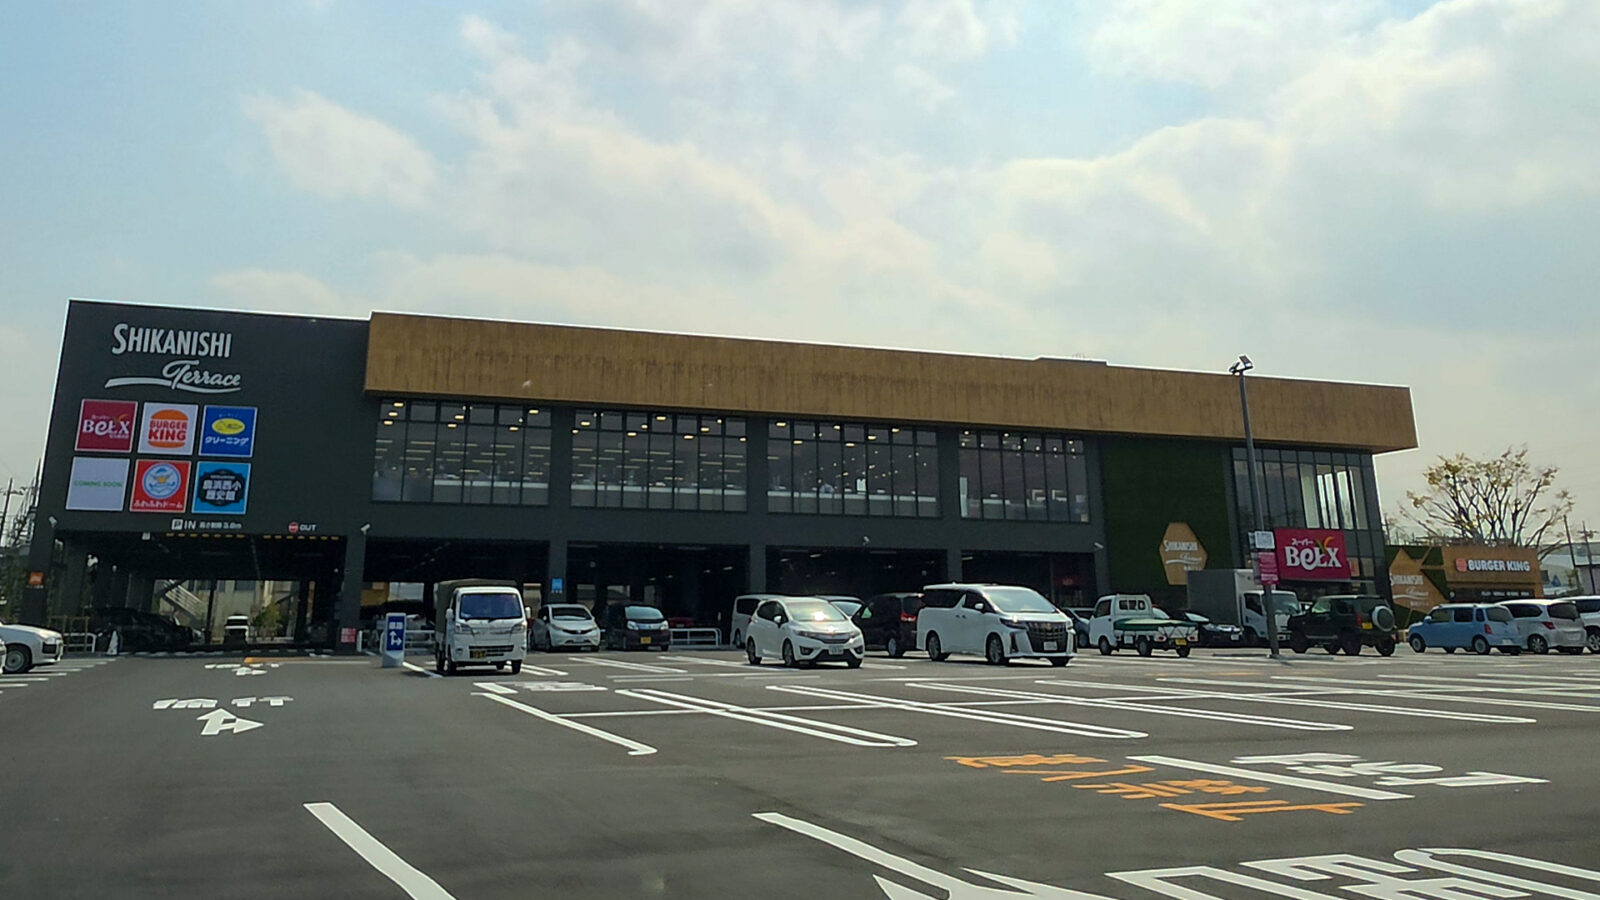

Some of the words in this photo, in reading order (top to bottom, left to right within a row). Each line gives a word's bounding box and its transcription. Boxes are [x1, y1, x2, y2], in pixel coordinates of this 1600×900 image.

[162, 359, 241, 390] Terrace
[149, 420, 188, 430] BURGER
[148, 429, 187, 442] KING
[205, 435, 249, 447] クリーニング
[133, 499, 183, 509] ふわふわドーム
[184, 520, 197, 530] IN
[299, 524, 317, 532] OUT
[1468, 559, 1506, 572] BURGER
[1506, 560, 1531, 572] KING
